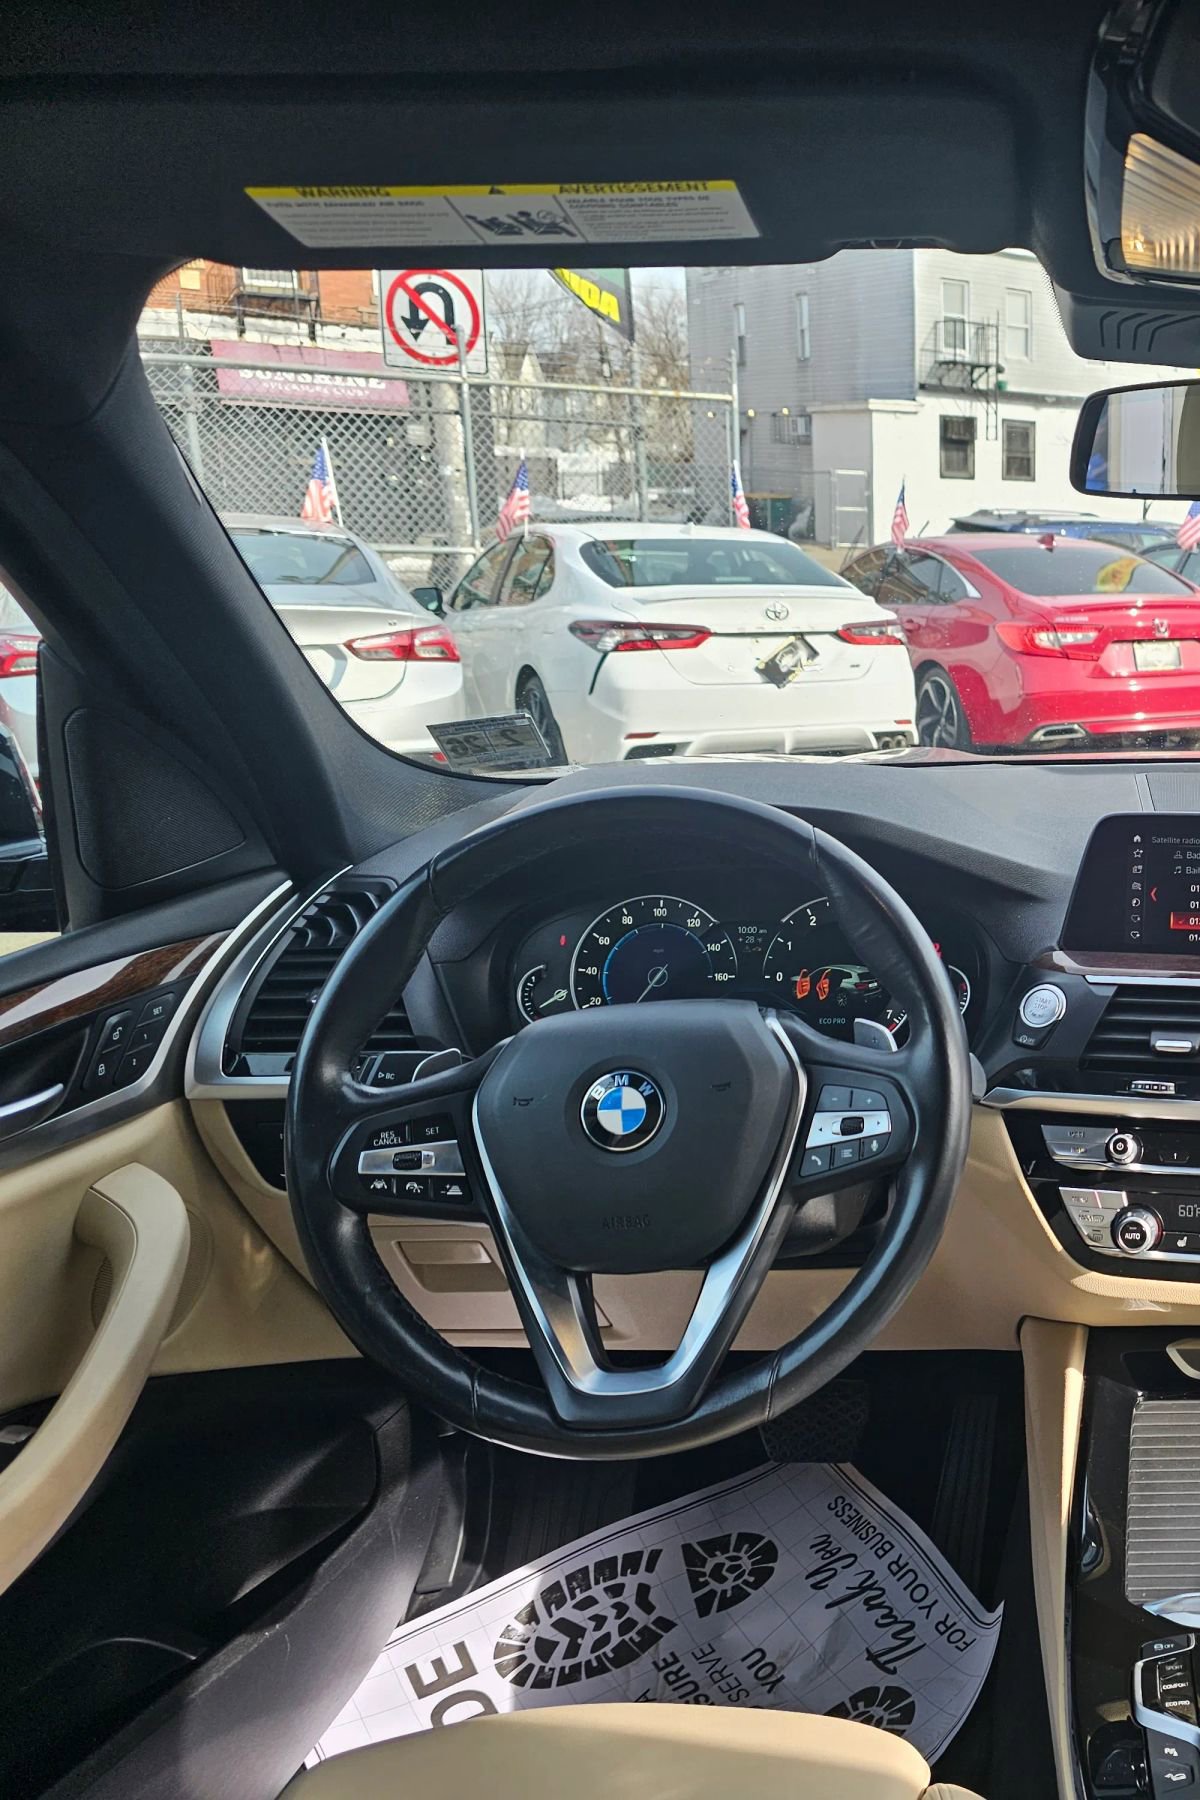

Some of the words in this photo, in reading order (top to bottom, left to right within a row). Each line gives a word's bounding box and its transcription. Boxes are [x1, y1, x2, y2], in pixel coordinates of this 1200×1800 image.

[297, 186, 391, 198] WARNING
[559, 182, 711, 195] AVERTISSEMENT
[1151, 836, 1181, 845] Satellite
[1182, 837, 1200, 845] radio
[1186, 852, 1200, 860] Bad
[653, 908, 668, 917] 100
[621, 915, 633, 925] 80
[686, 918, 701, 928] 120
[809, 916, 817, 926] 2
[737, 926, 758, 934] 10:00
[598, 936, 610, 945] 60
[745, 935, 755, 944] 28
[706, 943, 721, 952] 140
[786, 941, 792, 951] 1
[585, 966, 598, 975] 40
[714, 972, 729, 981] 160
[776, 972, 783, 981] 0
[589, 996, 602, 1006] 20
[152, 1006, 163, 1016] SET
[885, 1009, 893, 1019] 7
[818, 1017, 832, 1025] ECO
[833, 1017, 846, 1025] PRO
[590, 1074, 655, 1101] BMW
[380, 1130, 395, 1139] RES
[425, 1126, 440, 1136] SET
[373, 1136, 403, 1147] CANCEL
[1172, 1152, 1178, 1160] 1
[1124, 1231, 1141, 1241] AUTO
[826, 1495, 896, 1560] BUSINESS
[804, 1533, 858, 1591] You
[887, 1553, 939, 1620] YOUR
[824, 1569, 928, 1676] Thank
[934, 1613, 977, 1653] FOR
[691, 1642, 750, 1704] SERVE
[740, 1647, 787, 1695] YOU
[651, 1651, 717, 1706] SURE
[1162, 1682, 1189, 1691] COMFORT
[1165, 1700, 1178, 1708] ECO
[1178, 1699, 1191, 1707] PRO
